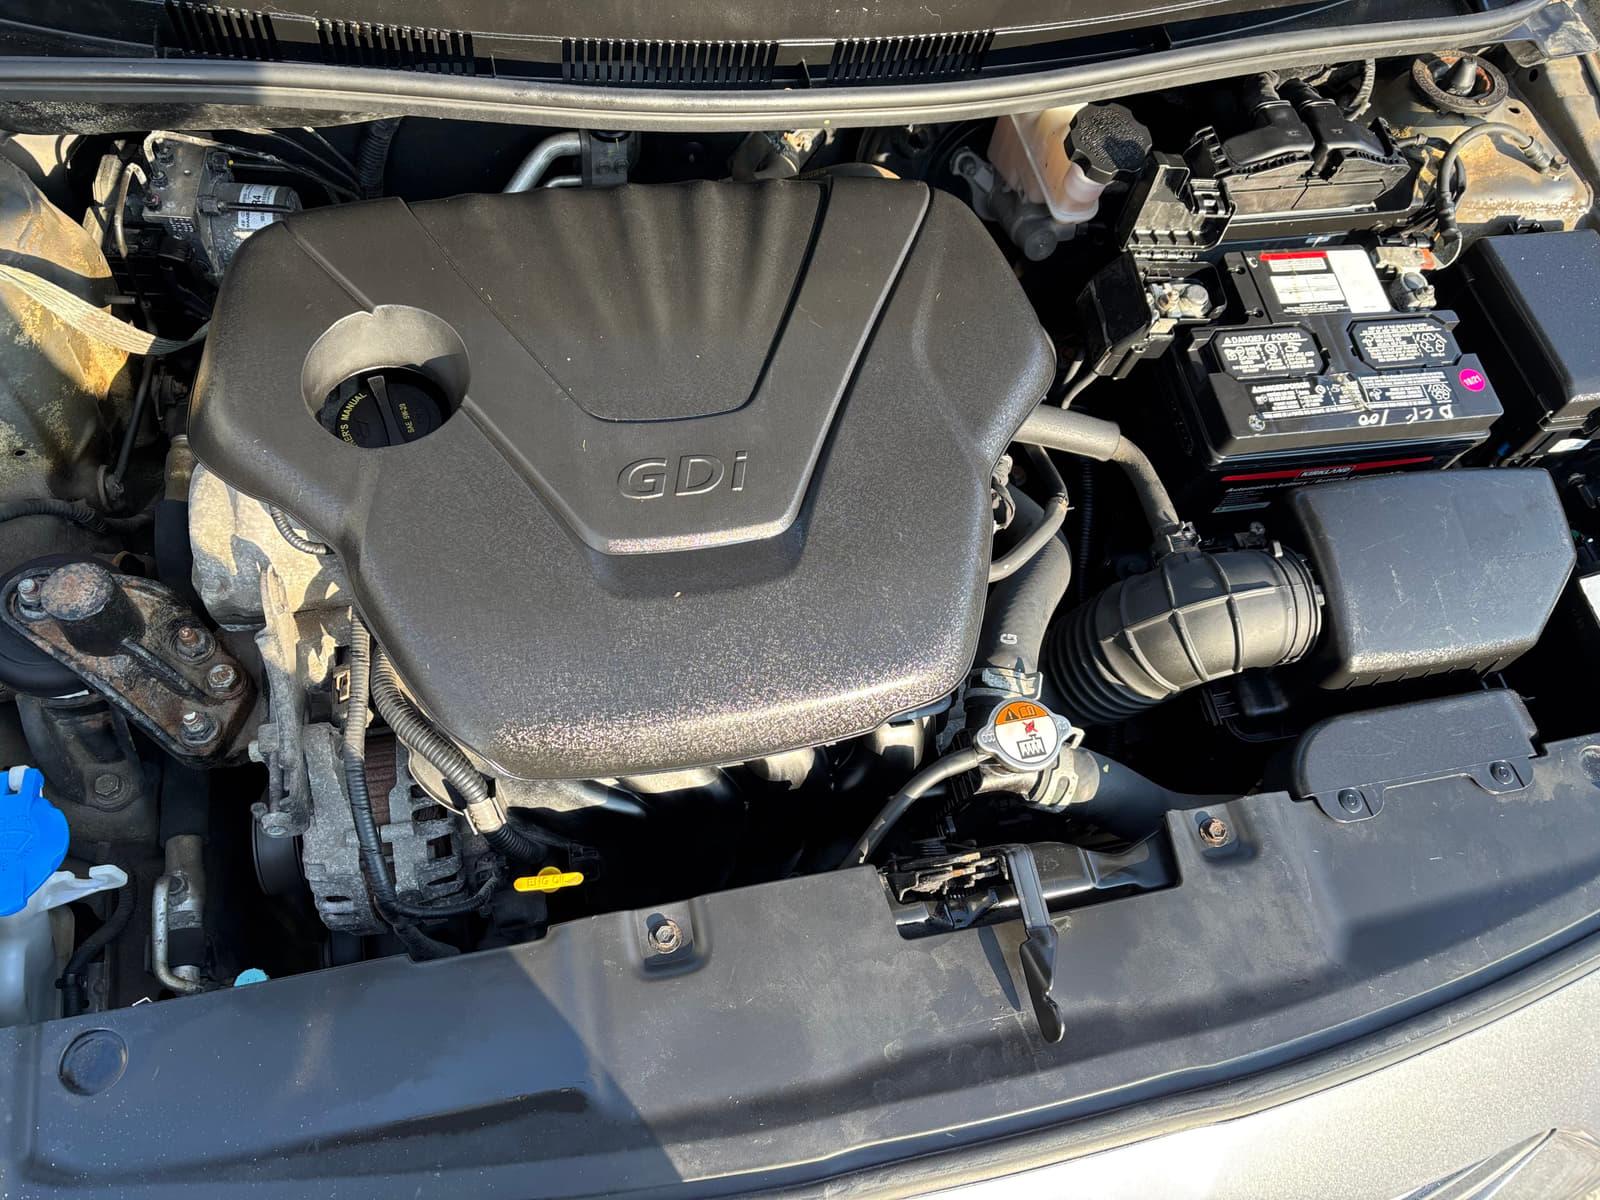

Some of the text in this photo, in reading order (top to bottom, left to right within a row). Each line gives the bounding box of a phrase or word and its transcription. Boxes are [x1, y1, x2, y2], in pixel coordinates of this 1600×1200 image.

[1231, 335, 1264, 344] DANGER
[1271, 332, 1300, 341] POISON
[341, 392, 367, 421] MANUAL
[617, 450, 747, 500] GDi
[1300, 467, 1351, 478] KIRKLAND
